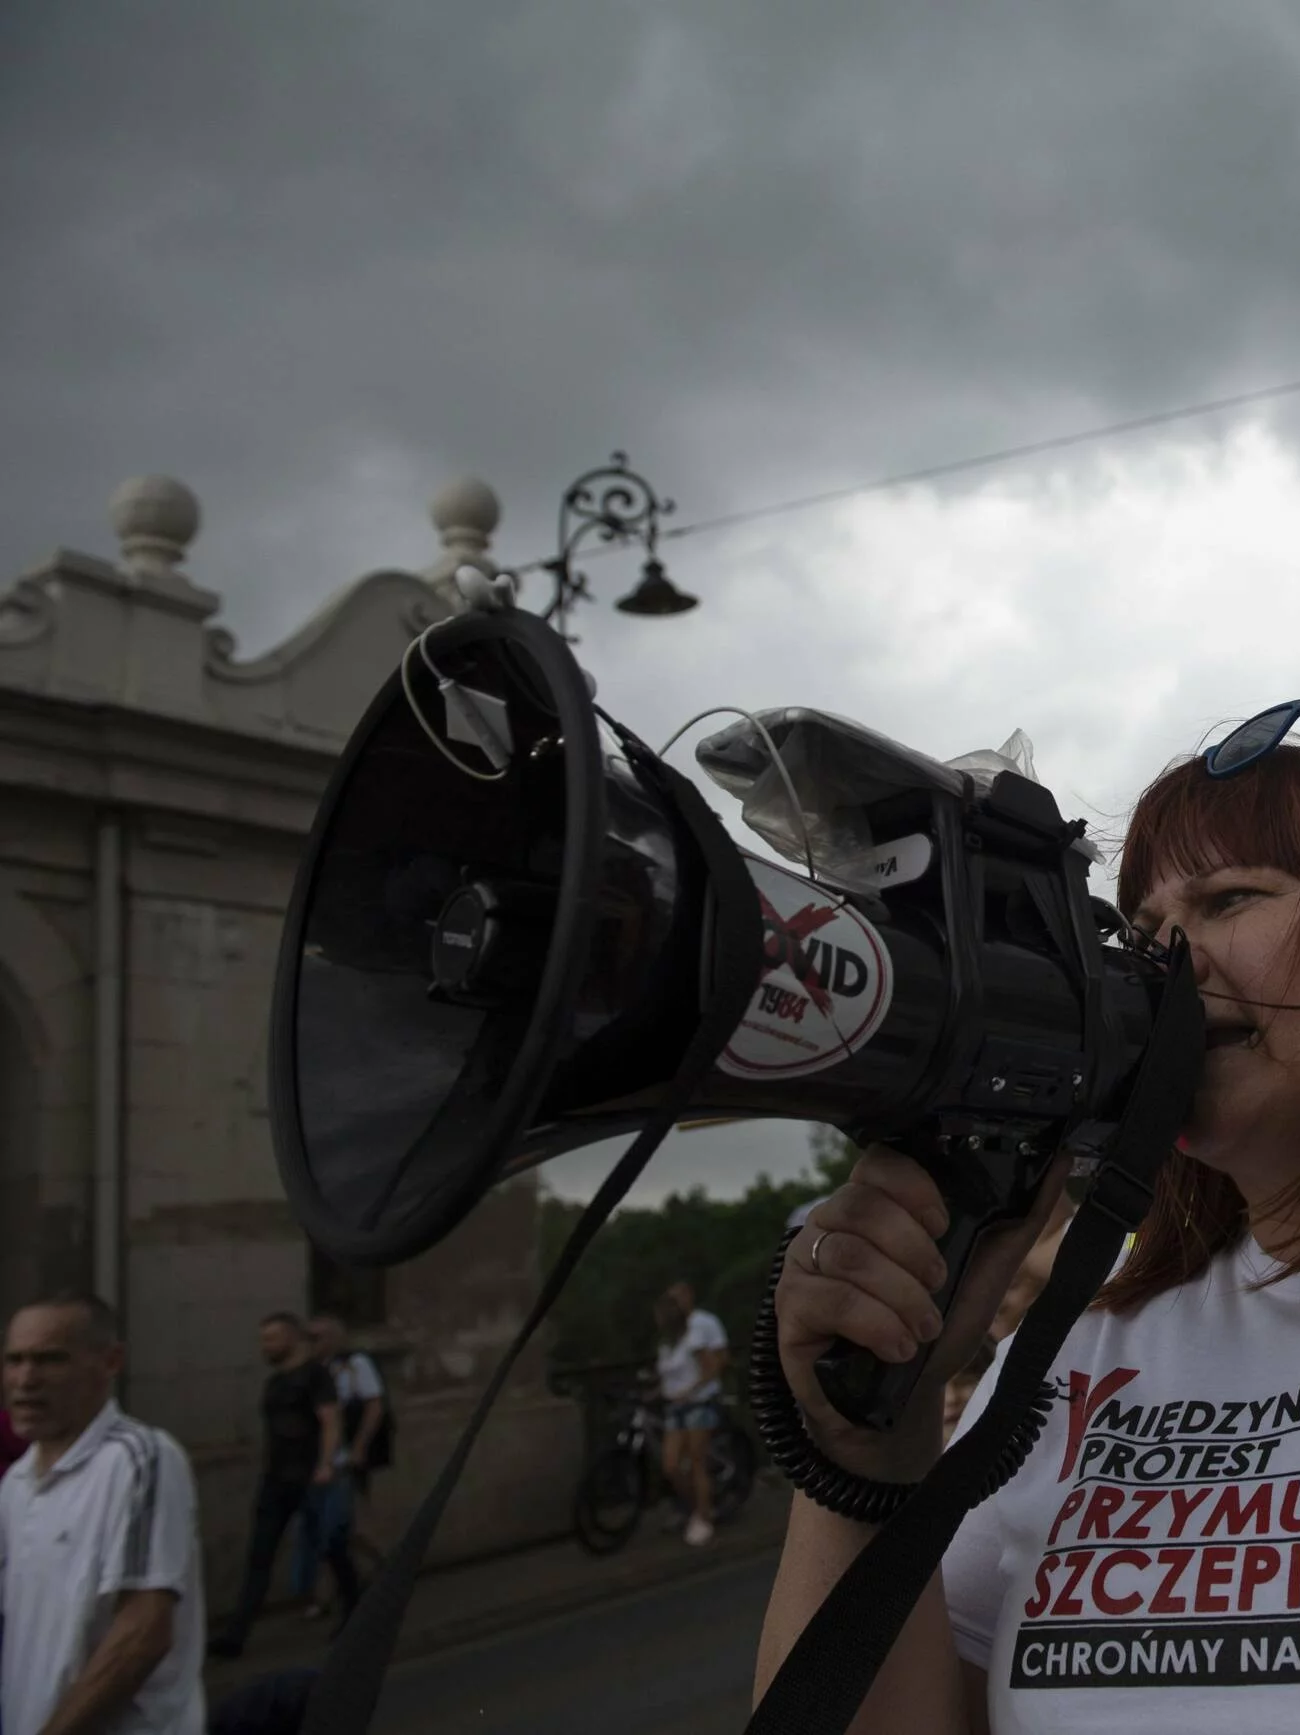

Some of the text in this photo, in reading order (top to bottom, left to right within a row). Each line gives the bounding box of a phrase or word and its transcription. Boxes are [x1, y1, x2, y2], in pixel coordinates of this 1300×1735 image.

[763, 919, 868, 998] OVID
[757, 982, 810, 1024] 1984
[1078, 1438, 1281, 1481] PROTEST
[1021, 1629, 1224, 1677] CHROŃMY
